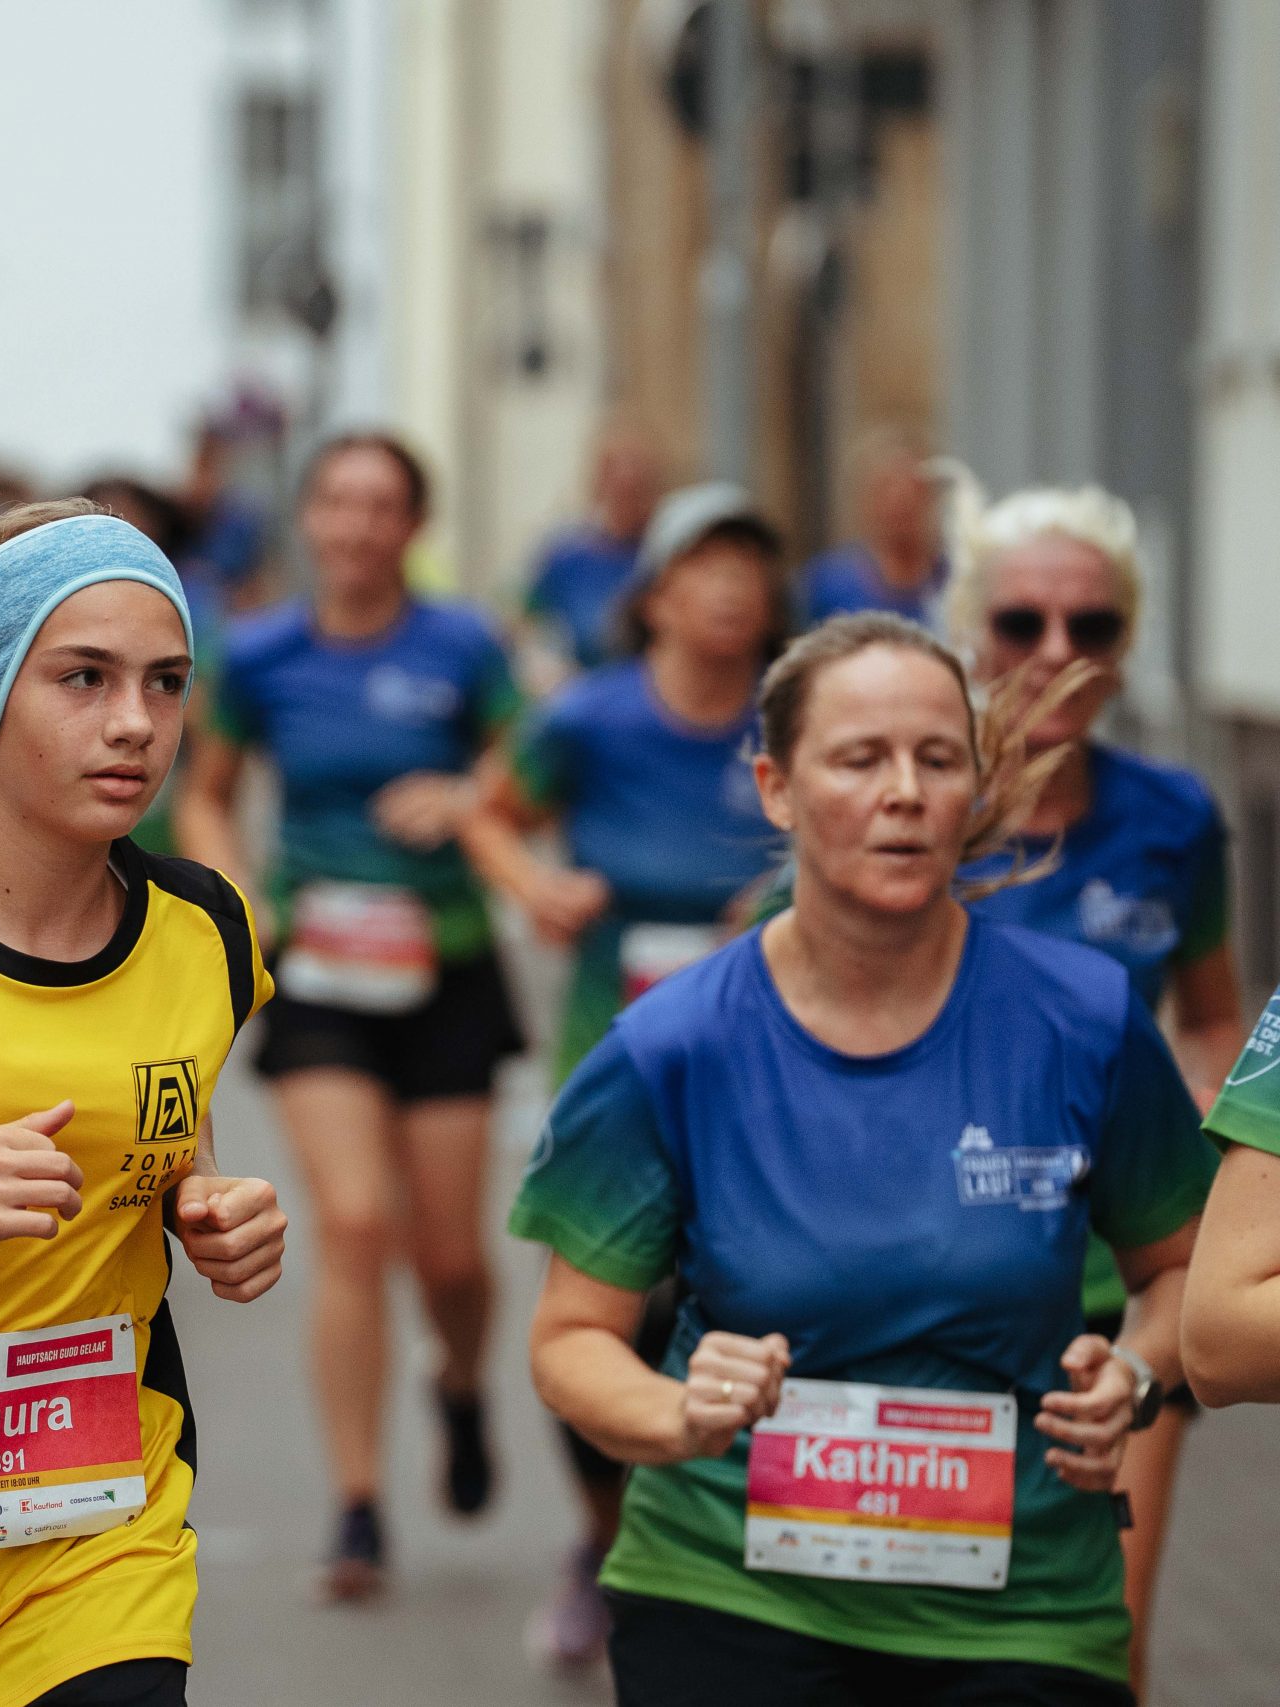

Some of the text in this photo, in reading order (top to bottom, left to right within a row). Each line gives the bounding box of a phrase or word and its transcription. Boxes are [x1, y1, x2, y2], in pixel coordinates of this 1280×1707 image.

[16, 1349, 58, 1366] HAUPTSACH
[80, 1340, 107, 1356] GELAAF
[793, 1437, 969, 1490] Kathrin
[27, 1476, 40, 1486] UHR
[33, 1500, 63, 1511] Kaufland
